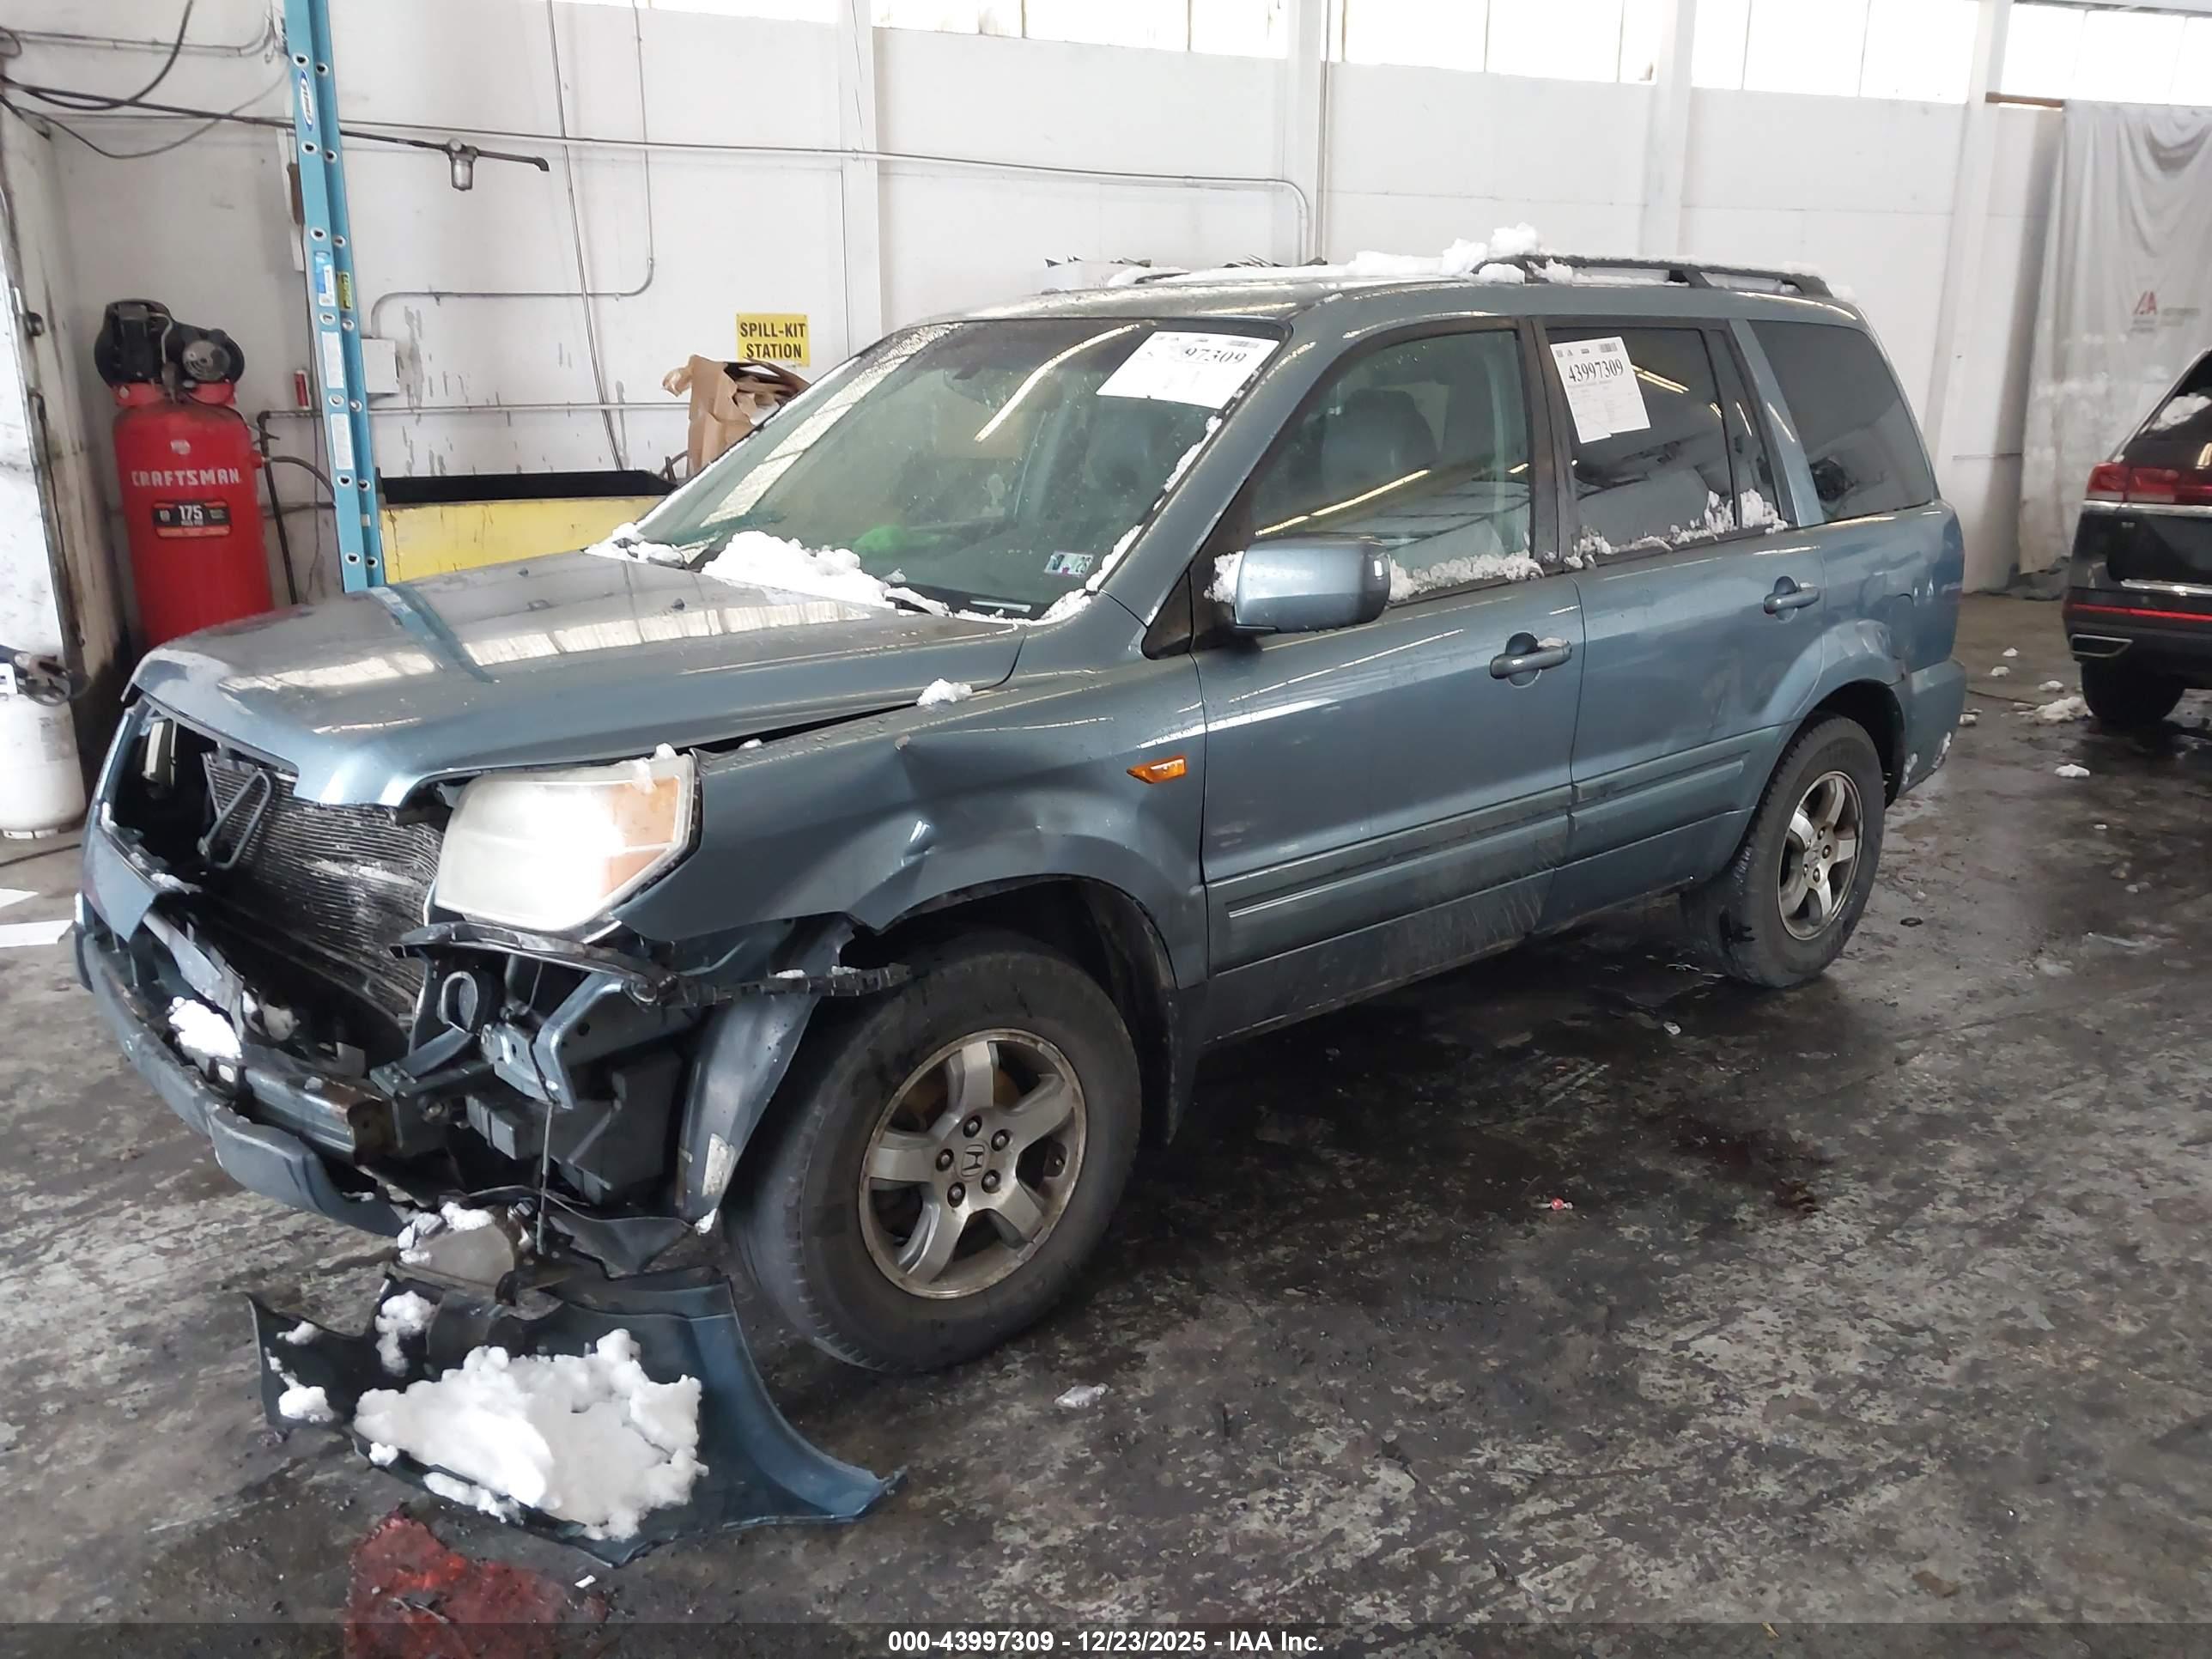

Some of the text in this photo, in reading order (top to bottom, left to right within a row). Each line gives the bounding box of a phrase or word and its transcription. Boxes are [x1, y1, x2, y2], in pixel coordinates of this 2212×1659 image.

[739, 322, 806, 337] SPILL-KIT
[746, 343, 802, 358] STATION
[1568, 358, 1624, 382] 43997309
[131, 468, 240, 486] CRAFTSMAN
[178, 504, 204, 520] 175
